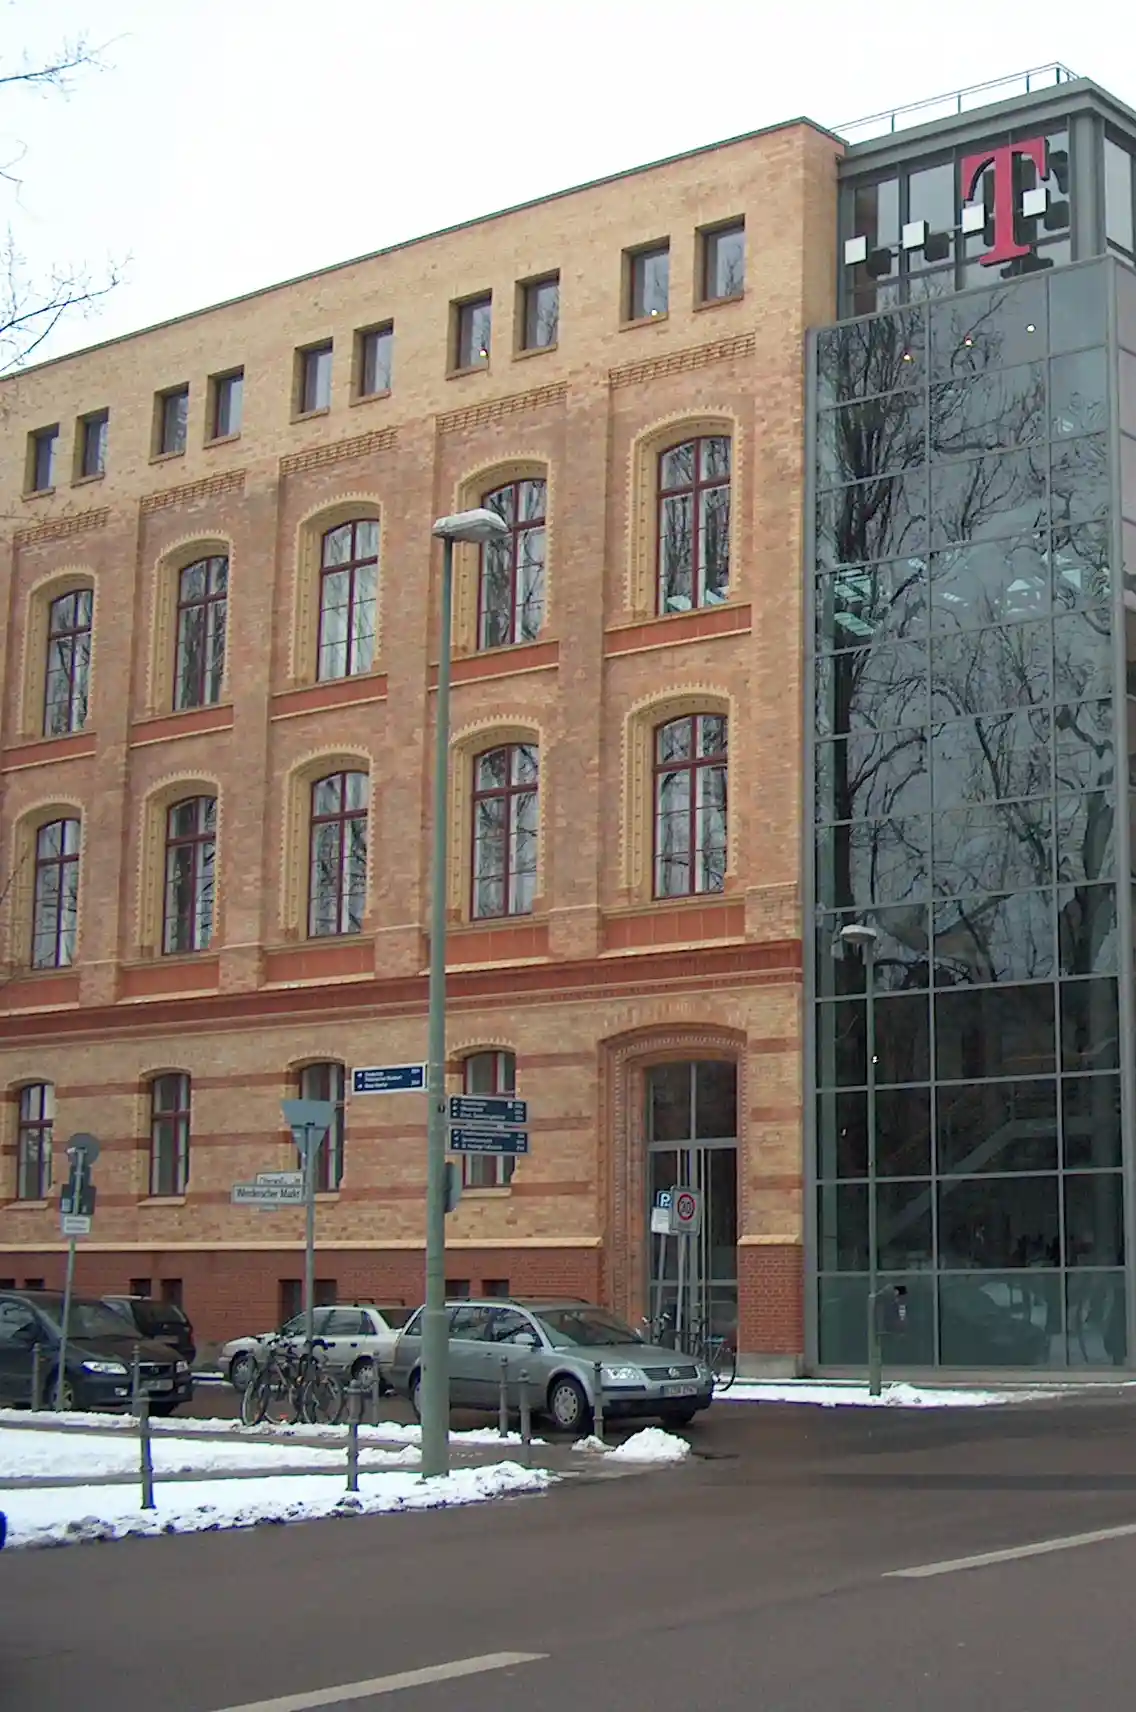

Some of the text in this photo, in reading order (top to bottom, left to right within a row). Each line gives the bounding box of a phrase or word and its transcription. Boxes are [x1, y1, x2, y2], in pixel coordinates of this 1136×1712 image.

[960, 136, 1050, 267] T
[279, 1188, 300, 1198] Markt
[660, 1193, 671, 1207] P
[680, 1200, 692, 1214] 30
